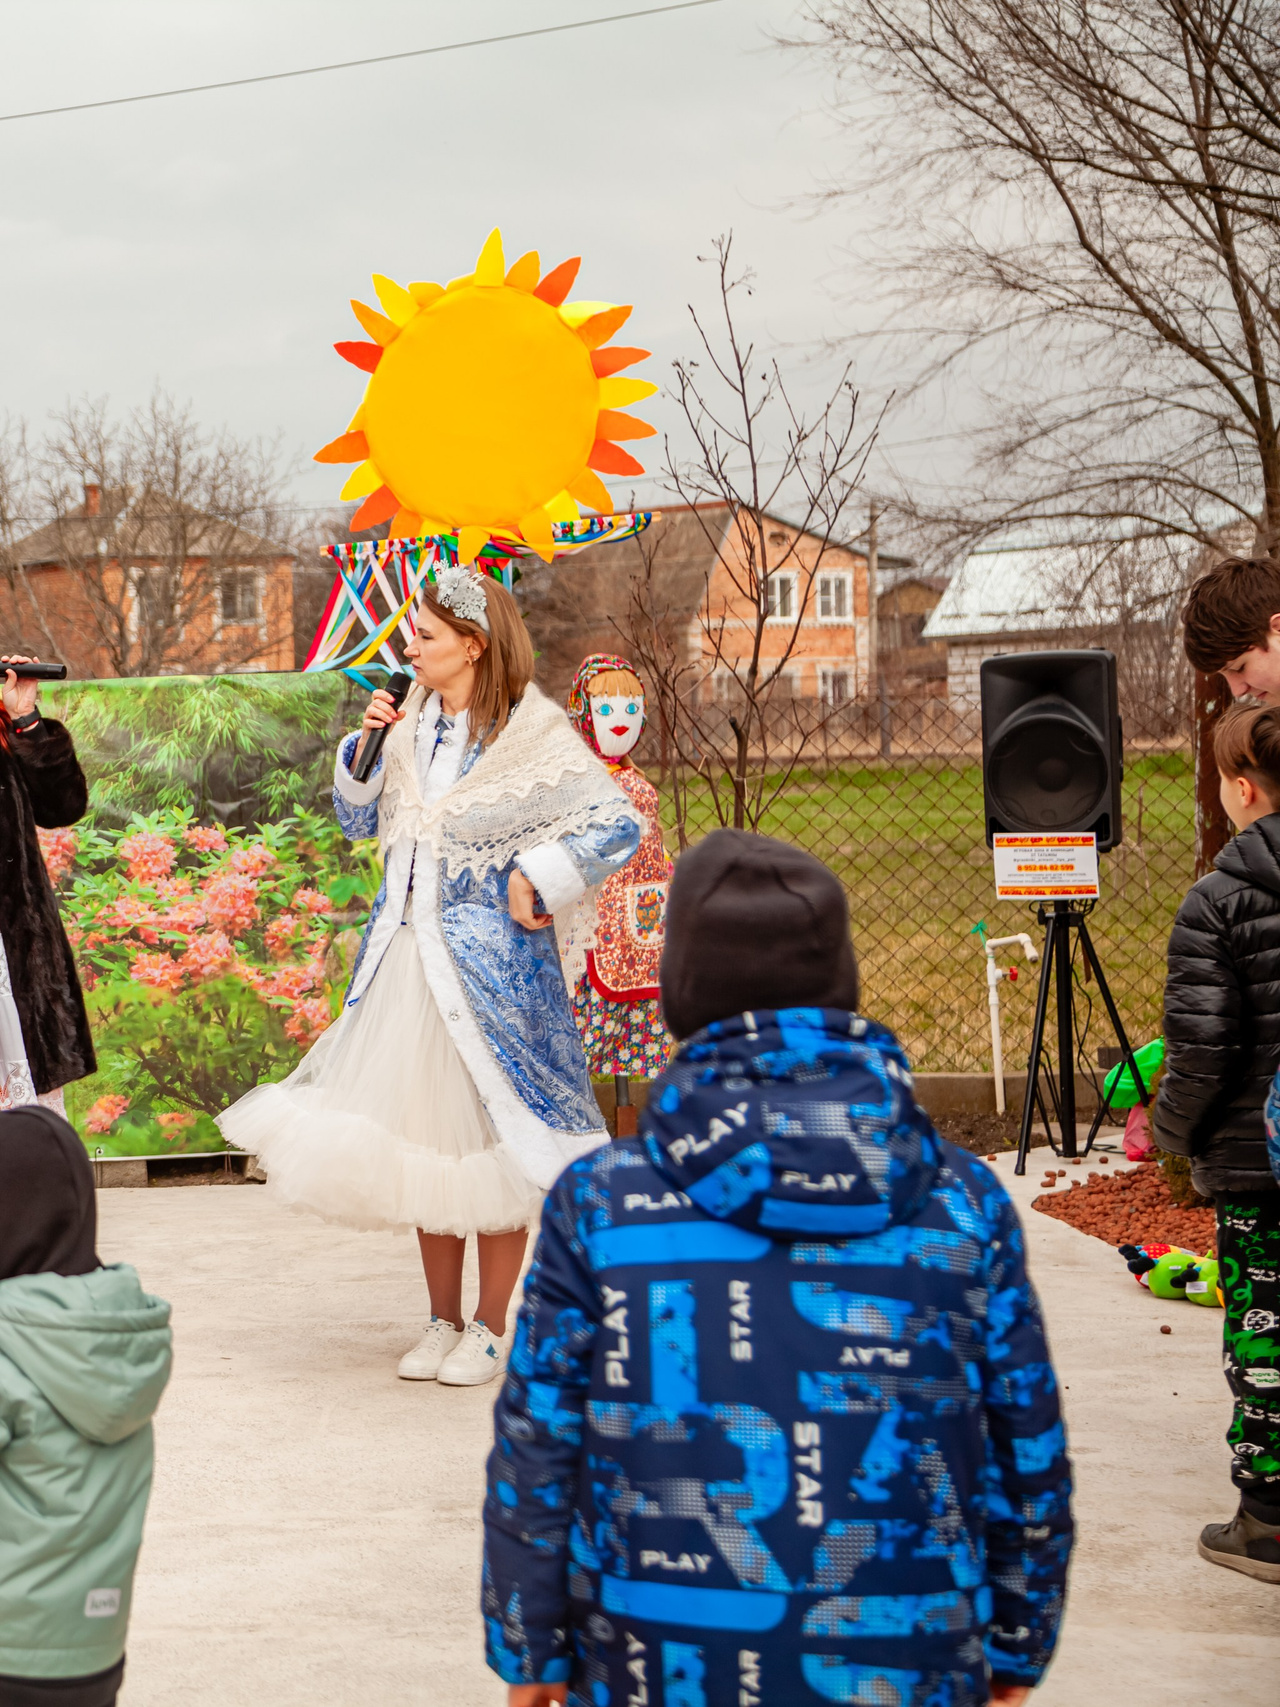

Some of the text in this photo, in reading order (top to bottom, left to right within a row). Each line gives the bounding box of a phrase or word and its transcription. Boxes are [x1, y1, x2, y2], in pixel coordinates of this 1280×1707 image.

[667, 1102, 749, 1166] PLAY
[780, 1170, 858, 1191] PLAY
[600, 1284, 630, 1388] PLAY
[728, 1280, 753, 1362] STAR
[838, 1346, 911, 1368] PLAY
[792, 1421, 824, 1528] STAR
[639, 1550, 713, 1574] PLAY
[624, 1631, 649, 1707] LAY
[738, 1649, 762, 1707] TAR
